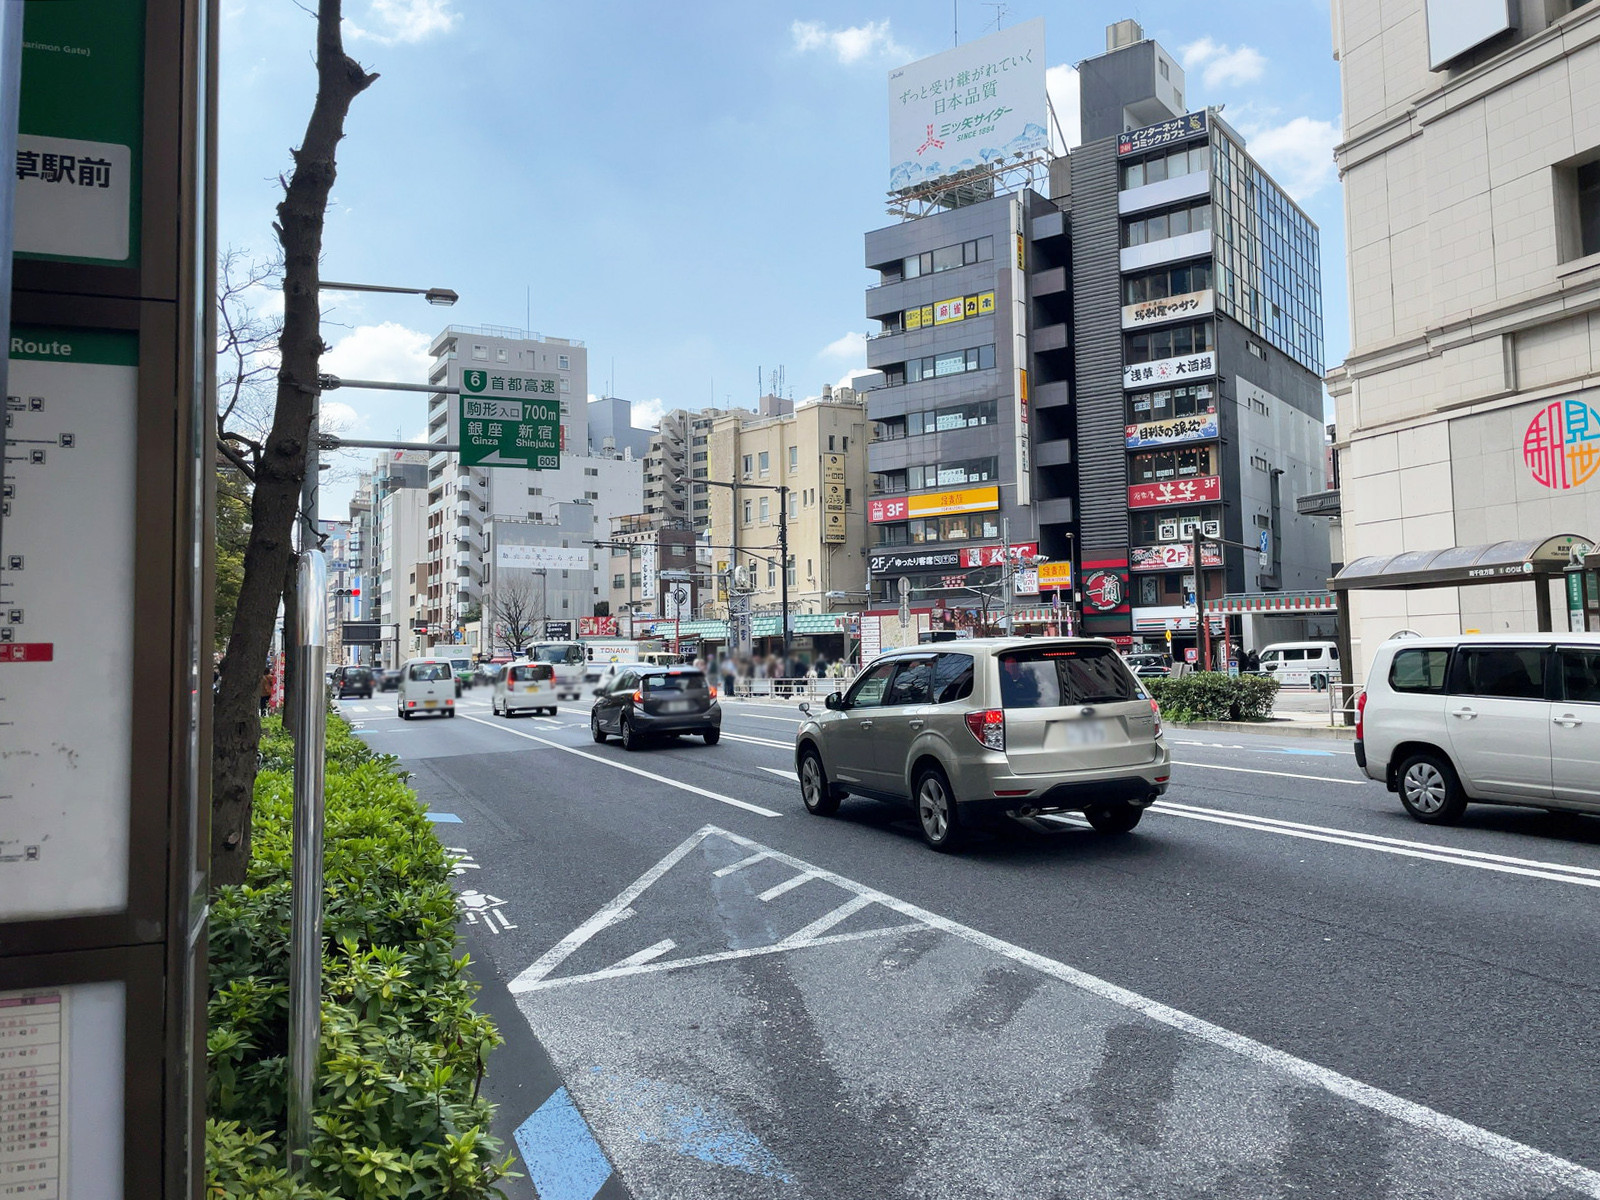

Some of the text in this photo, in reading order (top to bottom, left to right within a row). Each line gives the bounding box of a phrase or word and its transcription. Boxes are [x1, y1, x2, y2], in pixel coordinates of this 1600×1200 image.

[63, 45, 91, 57] Gate)
[899, 49, 1032, 105] ずっと受け継がれていく
[934, 79, 998, 116] 日本品質
[939, 106, 1013, 138] 三ツ矢サイダー
[1132, 119, 1185, 141] インターネット
[957, 125, 995, 142] SINCE 1884
[1133, 129, 1186, 150] コミックカフェ
[940, 302, 962, 317] 麻雀
[11, 338, 72, 356] Route
[1131, 357, 1212, 382] 浅草 大酒場
[470, 374, 481, 387] 6
[490, 376, 555, 394] 首都高速
[524, 404, 557, 421] 700m
[467, 421, 553, 440] 銀座 新宿
[1126, 426, 1137, 434] 4F
[471, 436, 555, 449] Ginza Shinjuku
[539, 456, 557, 466] 605
[1204, 478, 1216, 489] 3F
[886, 502, 904, 517] 3F
[871, 557, 886, 569] 2F
[990, 546, 1029, 564] KFC
[1166, 548, 1186, 563] 2F
